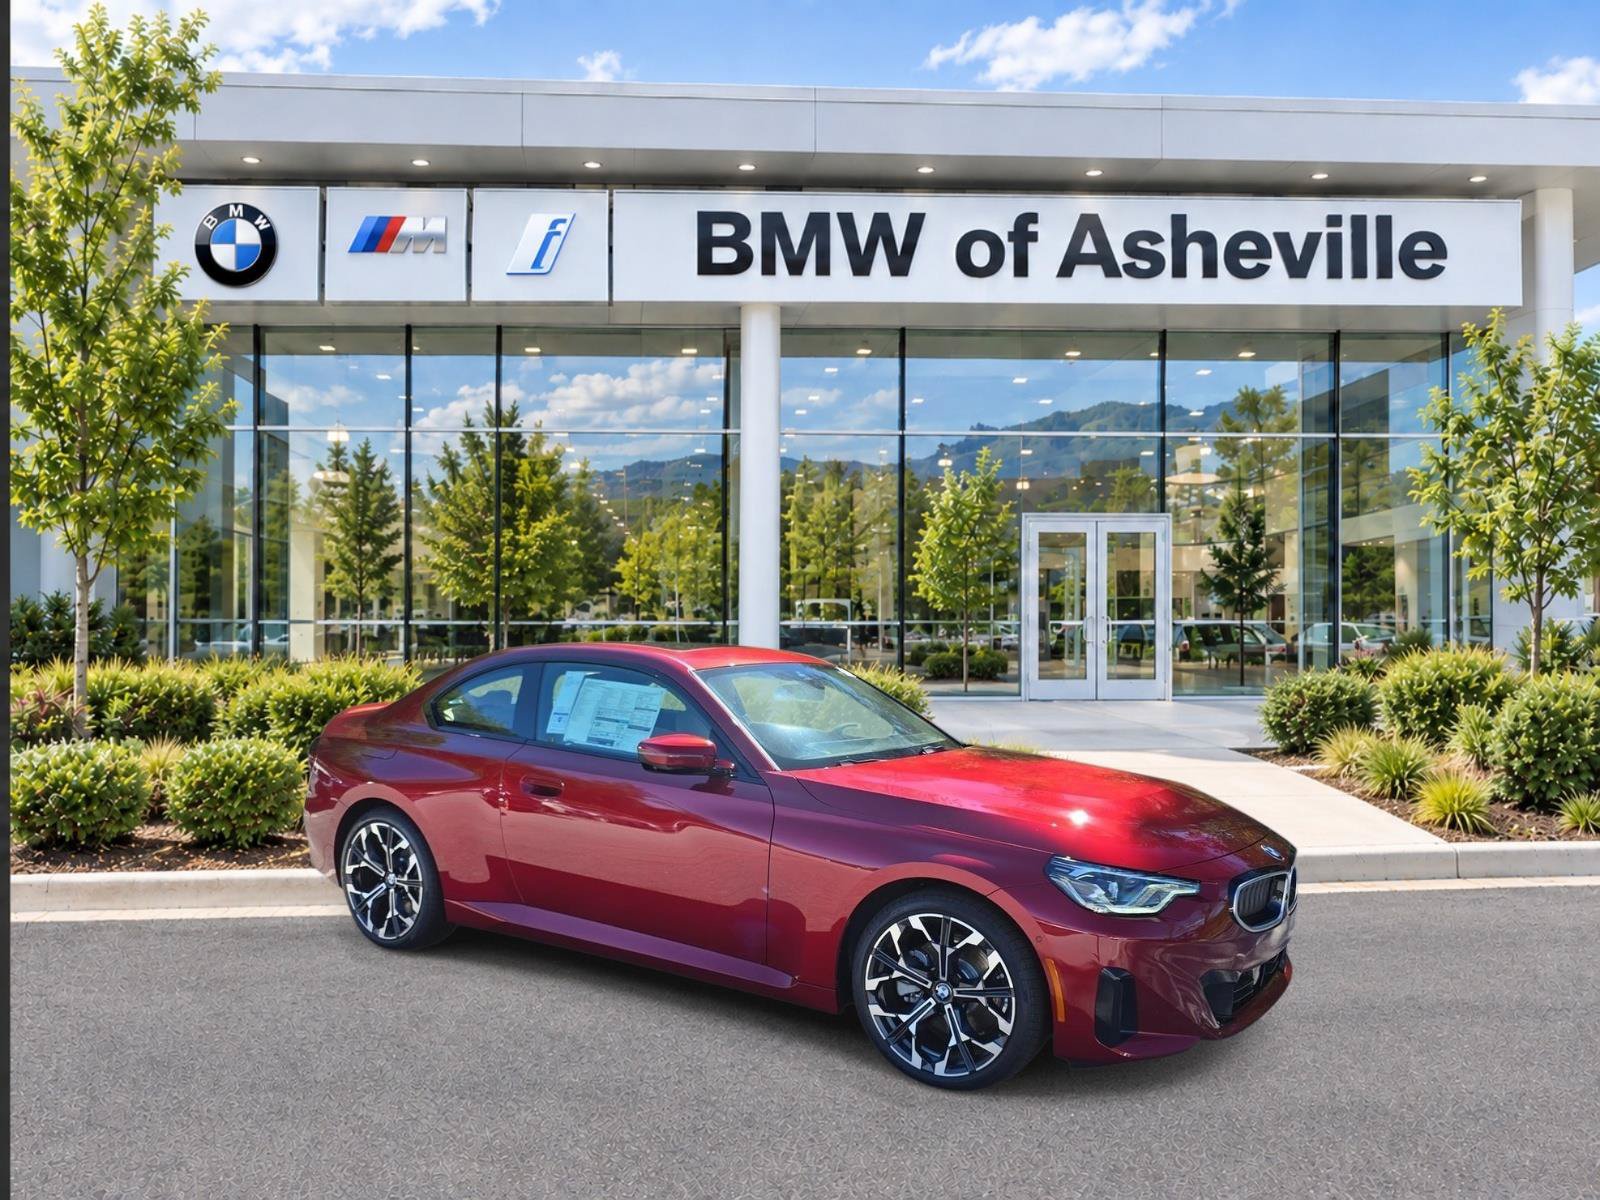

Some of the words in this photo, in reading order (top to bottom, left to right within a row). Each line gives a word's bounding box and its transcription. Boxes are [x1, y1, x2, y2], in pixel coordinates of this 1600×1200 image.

[202, 203, 272, 232] BMW
[696, 210, 926, 277] BMW
[955, 212, 1039, 279] of
[1056, 213, 1448, 280] Asheville
